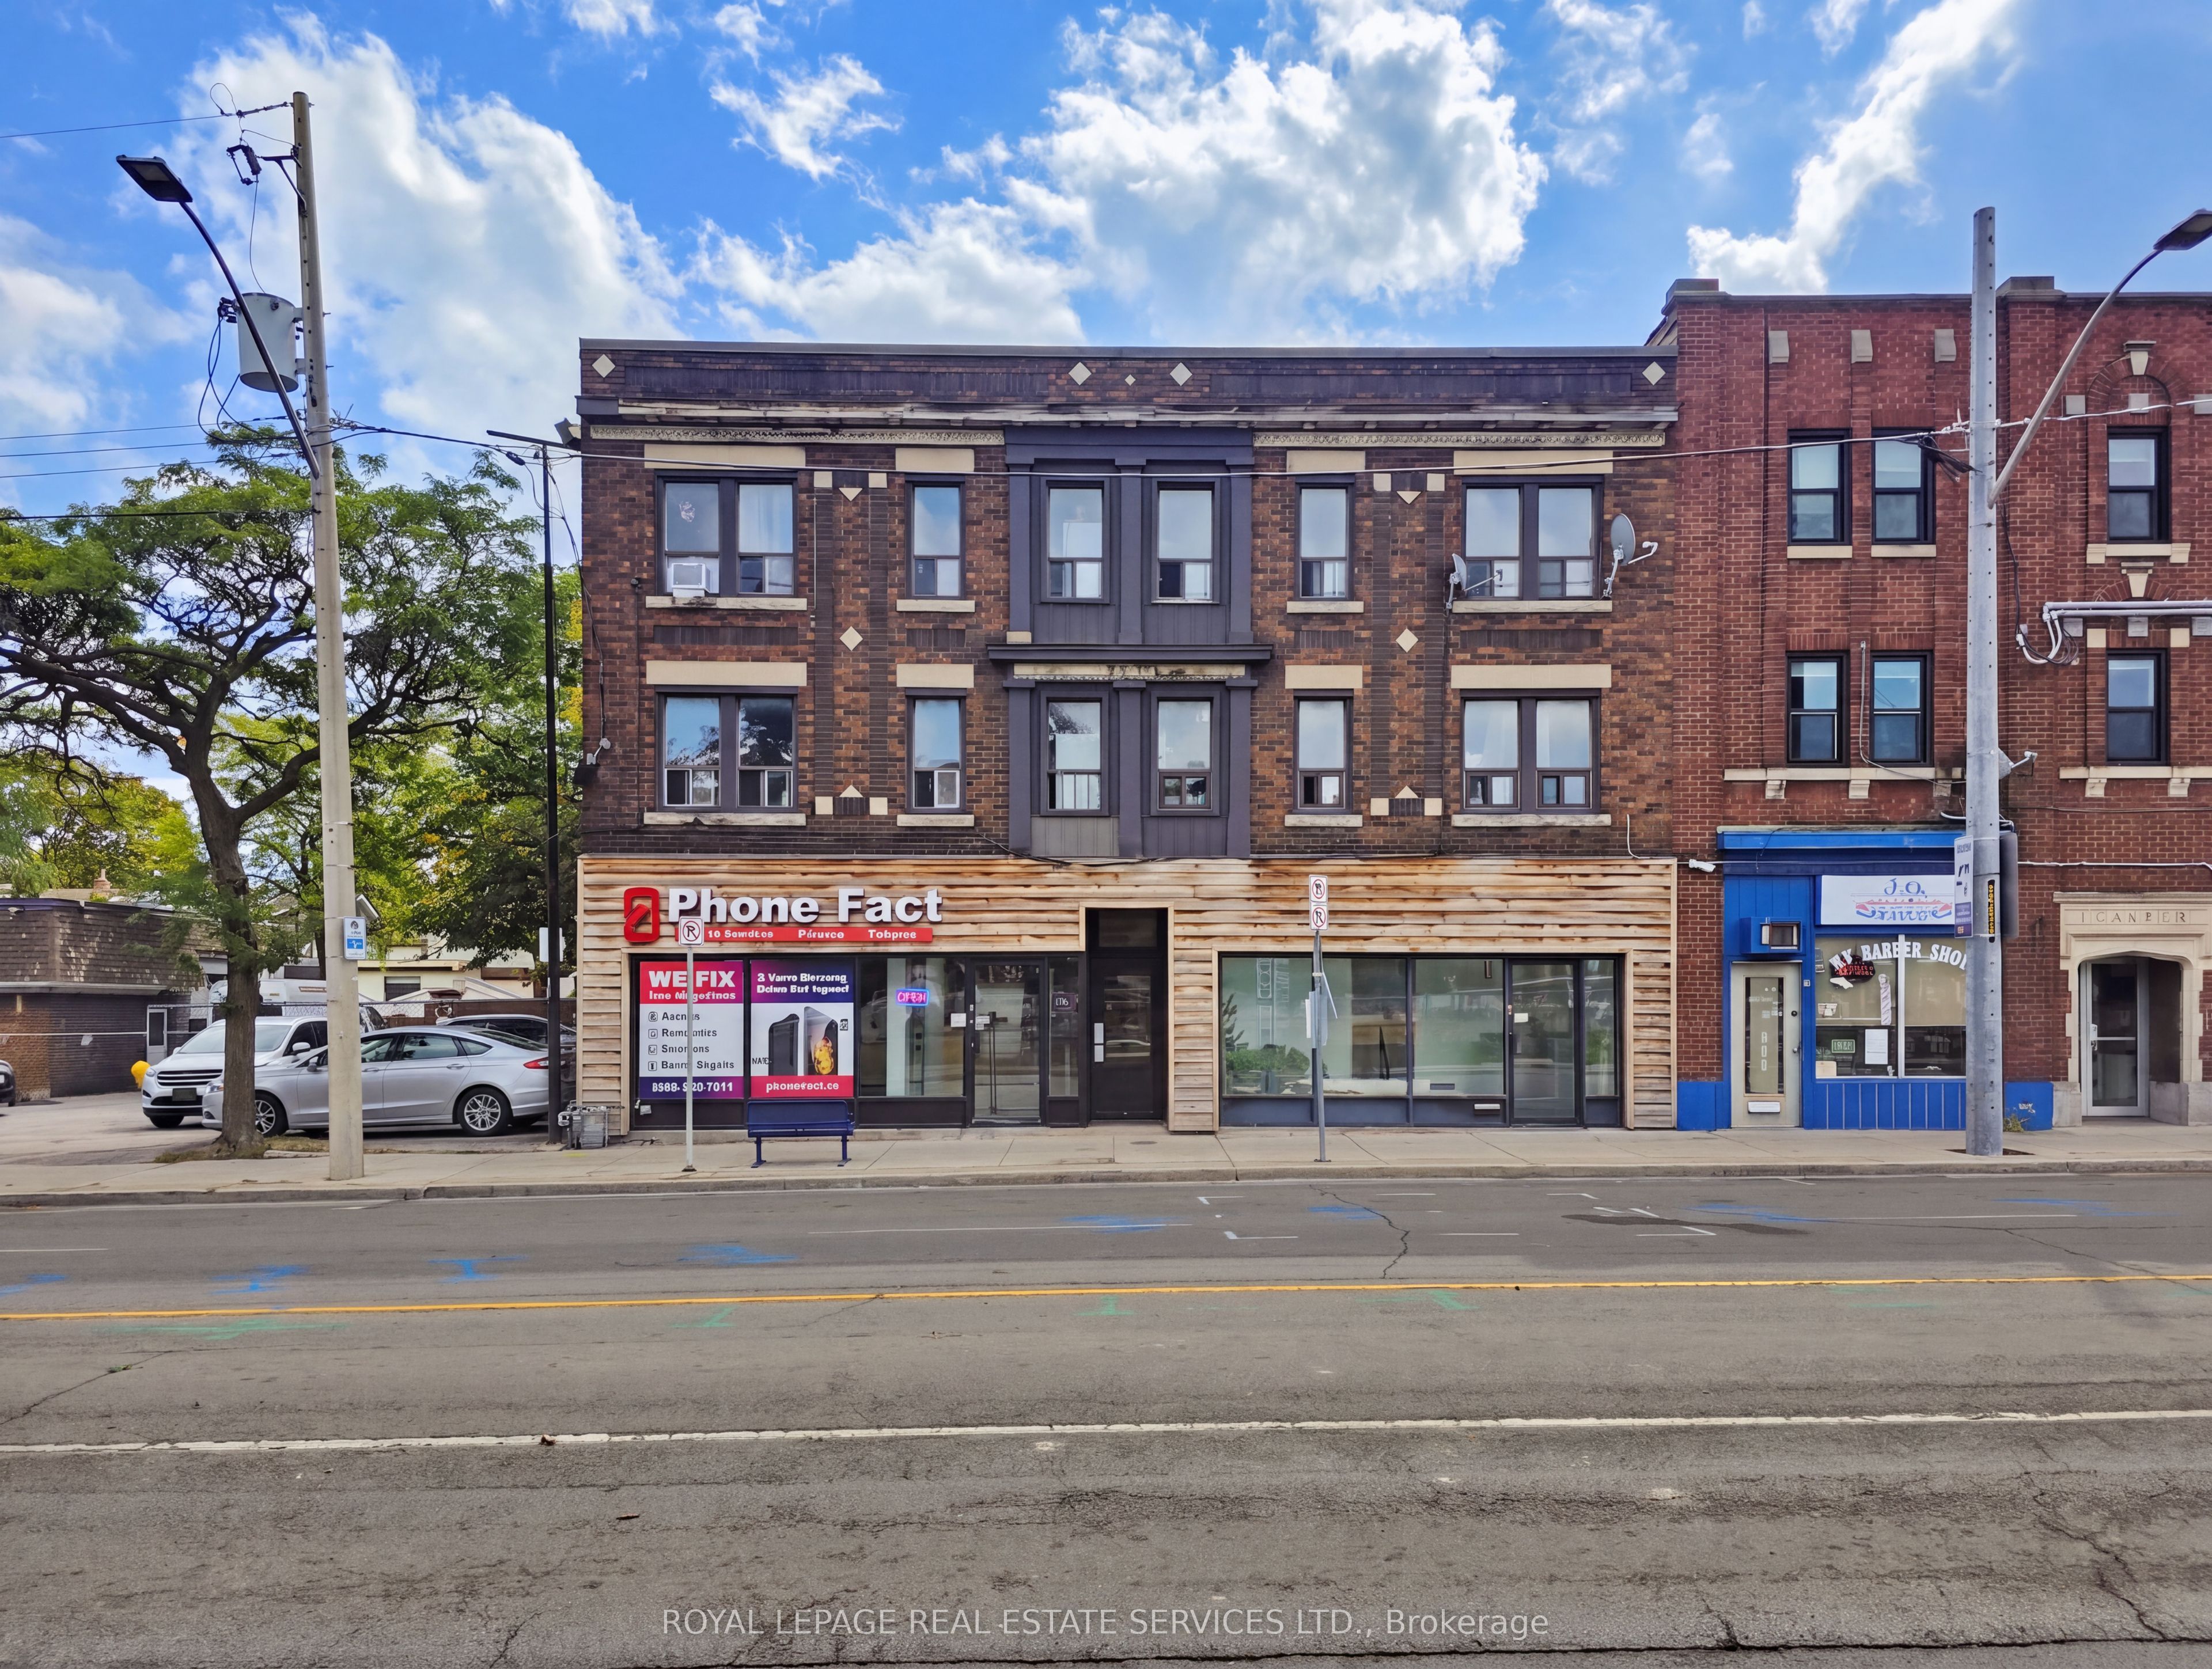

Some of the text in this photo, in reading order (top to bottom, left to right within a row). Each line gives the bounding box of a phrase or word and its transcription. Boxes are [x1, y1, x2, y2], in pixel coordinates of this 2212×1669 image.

[669, 888, 942, 923] Phone Fact
[649, 970, 736, 988] WE FIX
